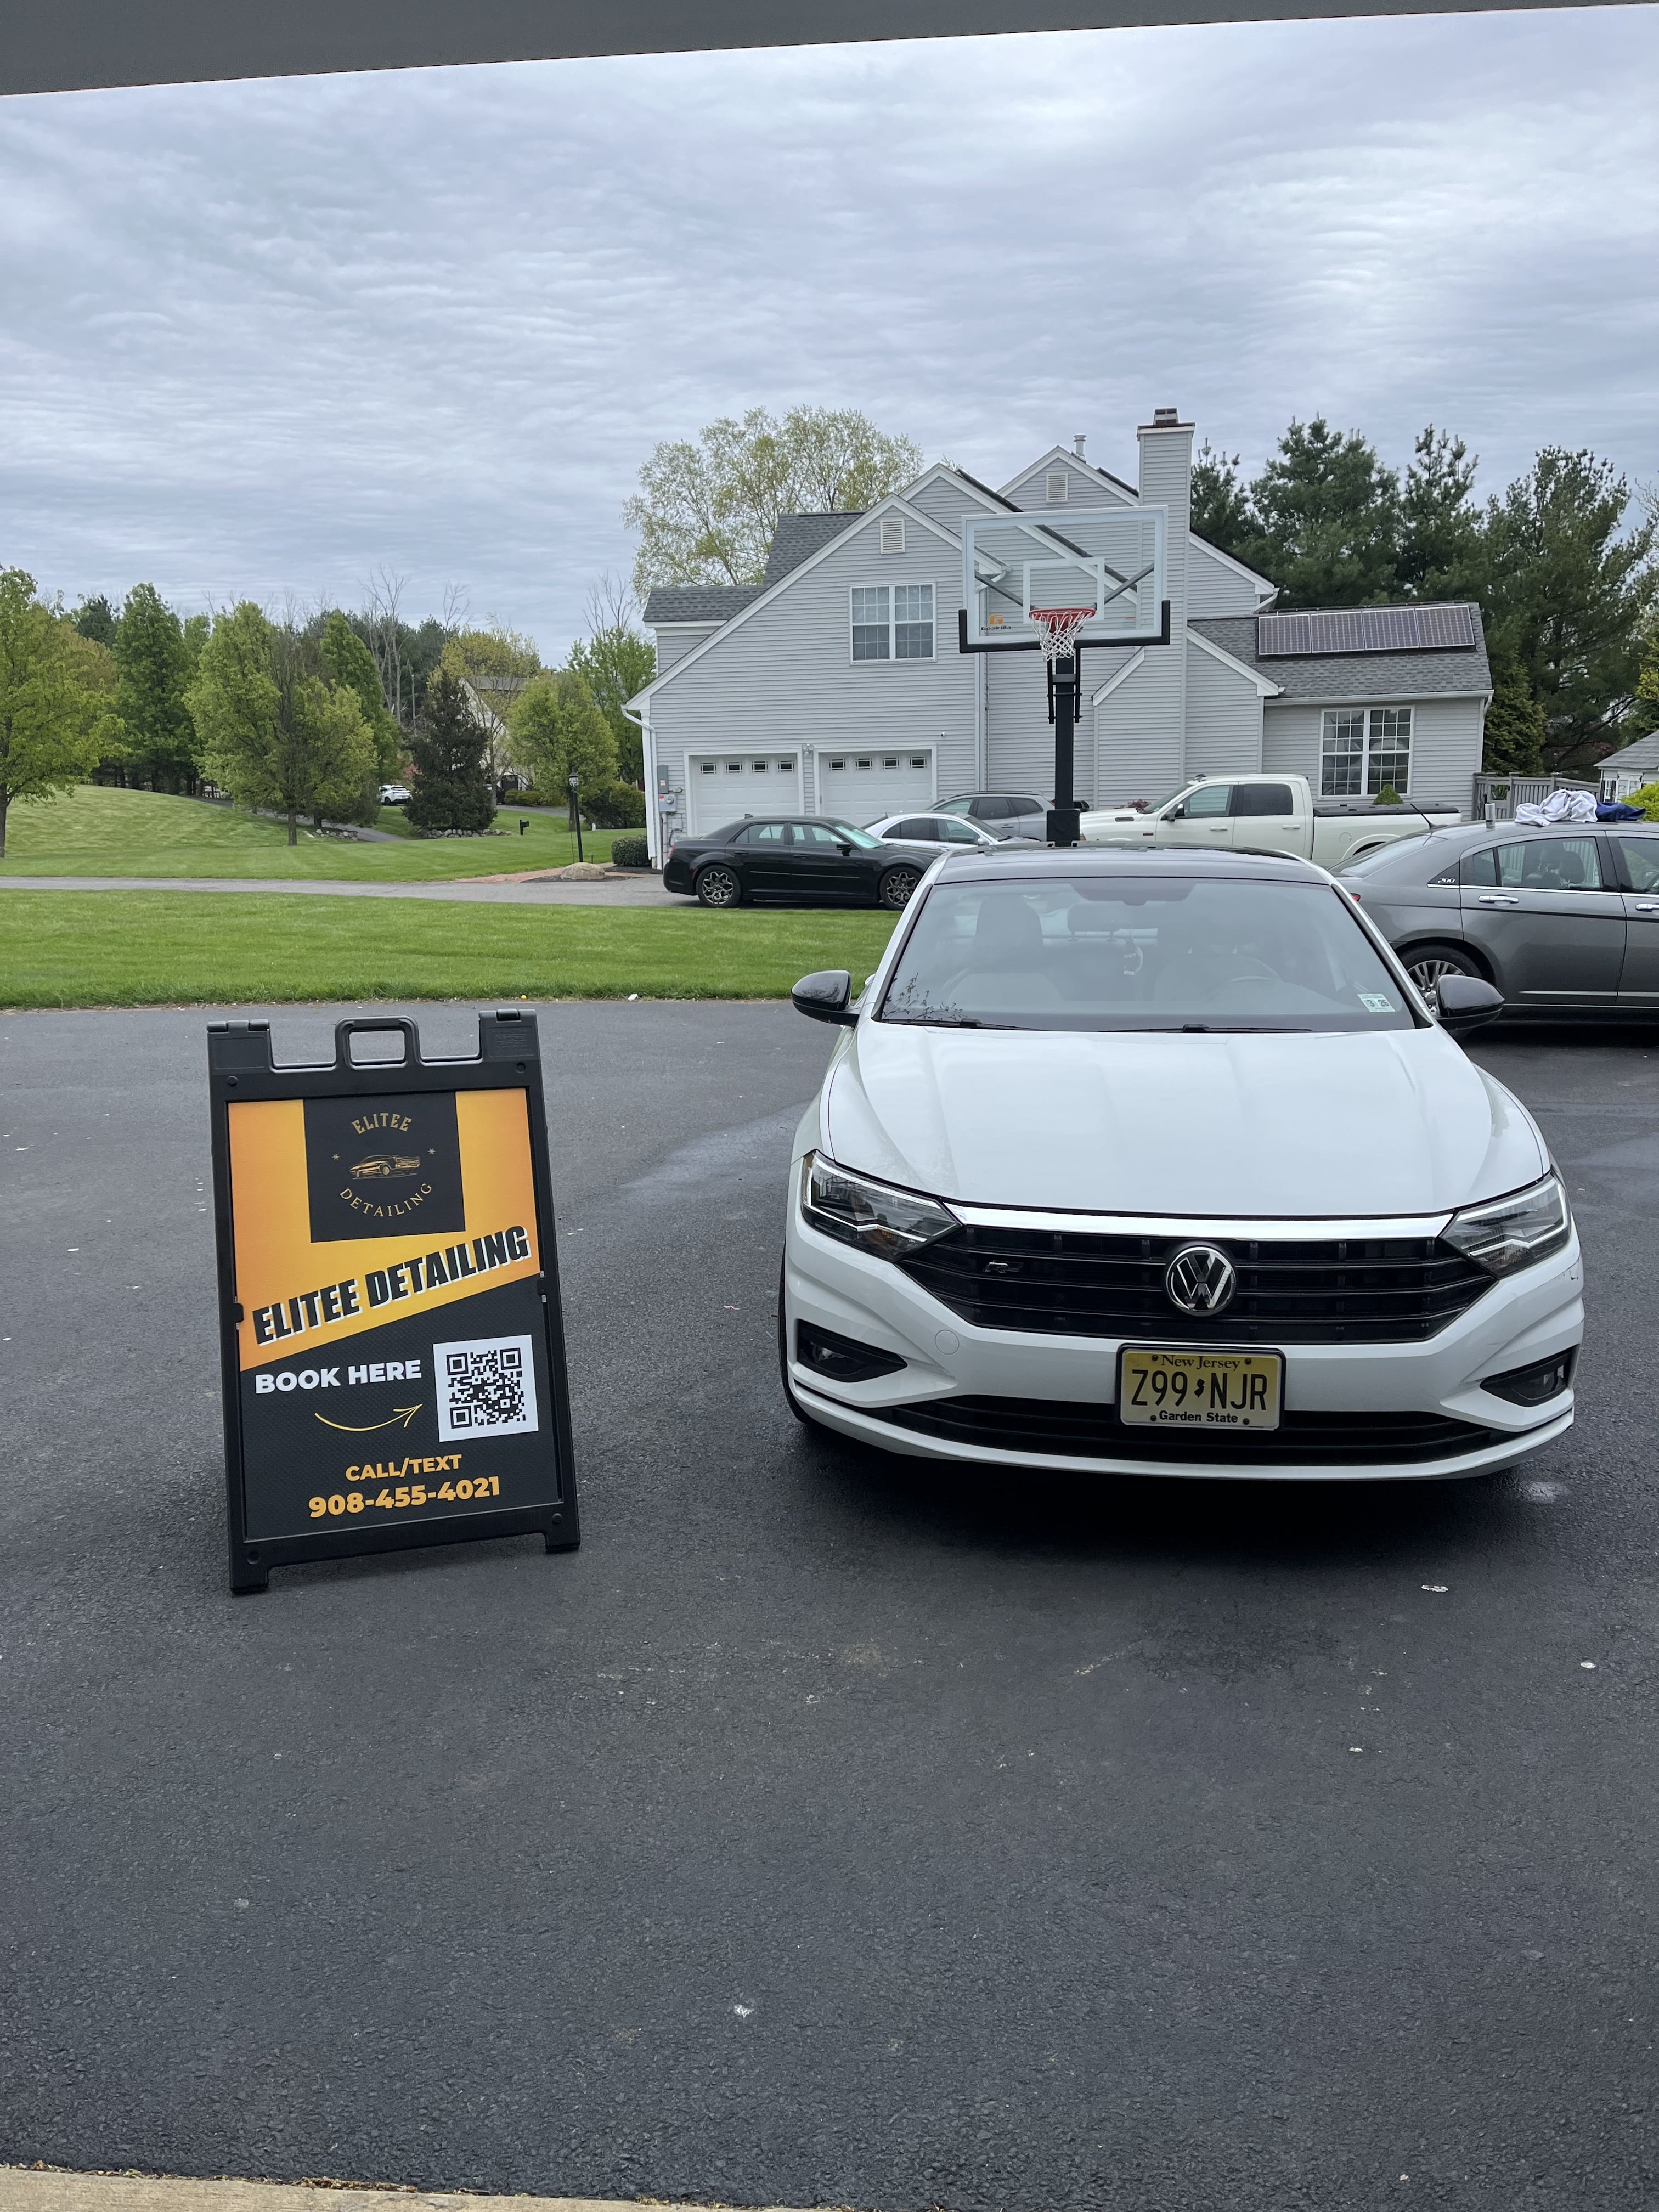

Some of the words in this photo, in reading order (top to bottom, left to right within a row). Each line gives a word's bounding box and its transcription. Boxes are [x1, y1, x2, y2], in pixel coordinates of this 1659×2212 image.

[351, 1113, 412, 1135] ELITEE
[339, 1183, 432, 1217] DETAILING
[252, 1278, 362, 1346] ELITEE
[365, 1226, 532, 1309] DETAILING
[255, 1368, 341, 1394] BOOK
[348, 1359, 422, 1385] HERE
[1161, 1355, 1194, 1367] New
[1197, 1356, 1240, 1371] Jersey
[1131, 1369, 1188, 1407] Z99
[1210, 1373, 1267, 1410] NJR
[1159, 1410, 1201, 1422] Garden
[1207, 1412, 1238, 1423] State
[346, 1454, 462, 1481] CALL/TEXT
[308, 1476, 500, 1518] 908-455-4021
